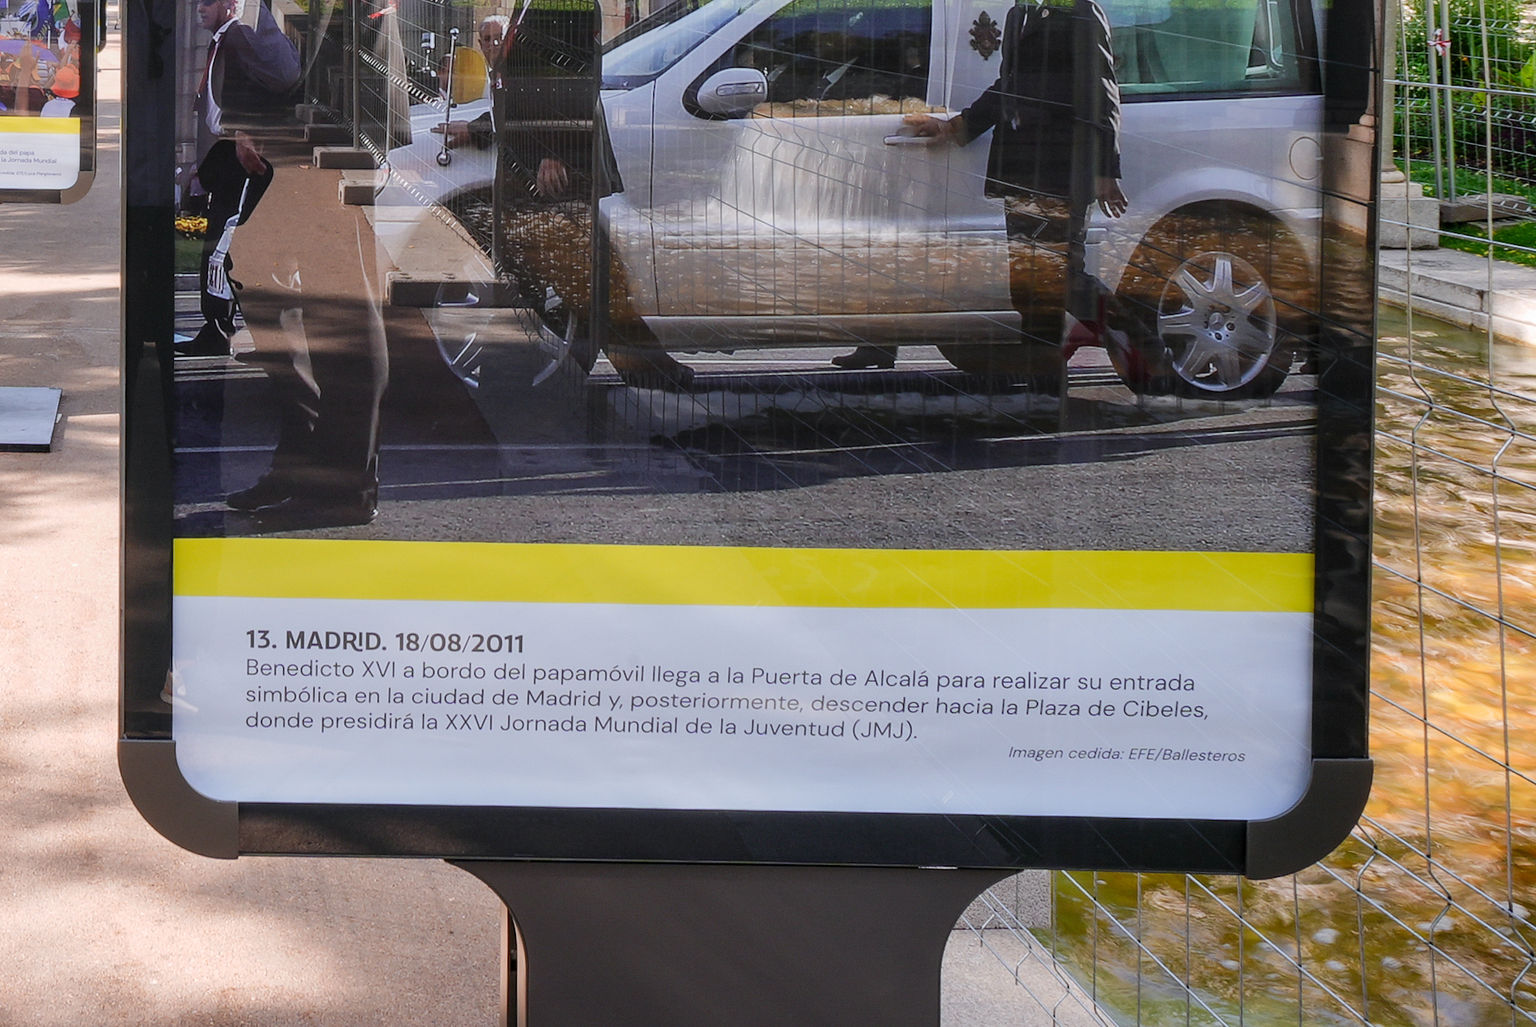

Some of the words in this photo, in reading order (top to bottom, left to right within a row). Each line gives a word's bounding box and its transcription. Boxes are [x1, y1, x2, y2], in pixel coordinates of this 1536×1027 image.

[246, 629, 277, 649] 13.
[286, 631, 386, 652] MADRID.
[396, 633, 523, 653] 18/08/2011
[247, 659, 354, 677] Benedicto
[362, 661, 395, 677] XVI
[404, 665, 414, 678] a
[422, 661, 486, 679] bordo
[494, 663, 525, 680] del
[534, 665, 644, 685] papamóvil
[652, 665, 700, 687] llega
[708, 671, 719, 683] a
[728, 667, 744, 683] la
[752, 667, 822, 685] Puerta
[830, 669, 857, 686] de
[864, 669, 928, 687] Alcalá
[937, 675, 984, 692] para
[993, 671, 1070, 689] realizar
[1078, 677, 1102, 690] su
[1110, 673, 1194, 691] entrada
[246, 685, 347, 703] simbólica
[355, 691, 380, 703] en
[388, 687, 404, 704] la
[412, 687, 484, 705] ciudad
[492, 689, 518, 705] de
[527, 689, 601, 707] Madrid
[608, 695, 622, 711] y,
[630, 693, 803, 713] posteriormente,
[812, 695, 929, 713] descender
[936, 697, 993, 715] hacia
[1002, 699, 1018, 715] la
[1026, 699, 1080, 716] Plaza
[1088, 699, 1116, 717] de
[1124, 700, 1208, 720] Cibeles,
[246, 711, 314, 729] donde
[322, 713, 414, 733] presidirá
[422, 713, 438, 730] la
[446, 714, 492, 731] XXVI
[500, 715, 586, 732] Jornada
[595, 716, 678, 733] Mundial
[686, 717, 712, 734] de
[720, 718, 736, 735] la
[744, 719, 844, 737] Juventud
[852, 719, 917, 742] (JMJ).
[1008, 747, 1064, 761] Imagen
[1068, 747, 1124, 759] cedida:
[1128, 747, 1246, 762] EFE/Ballesteros
